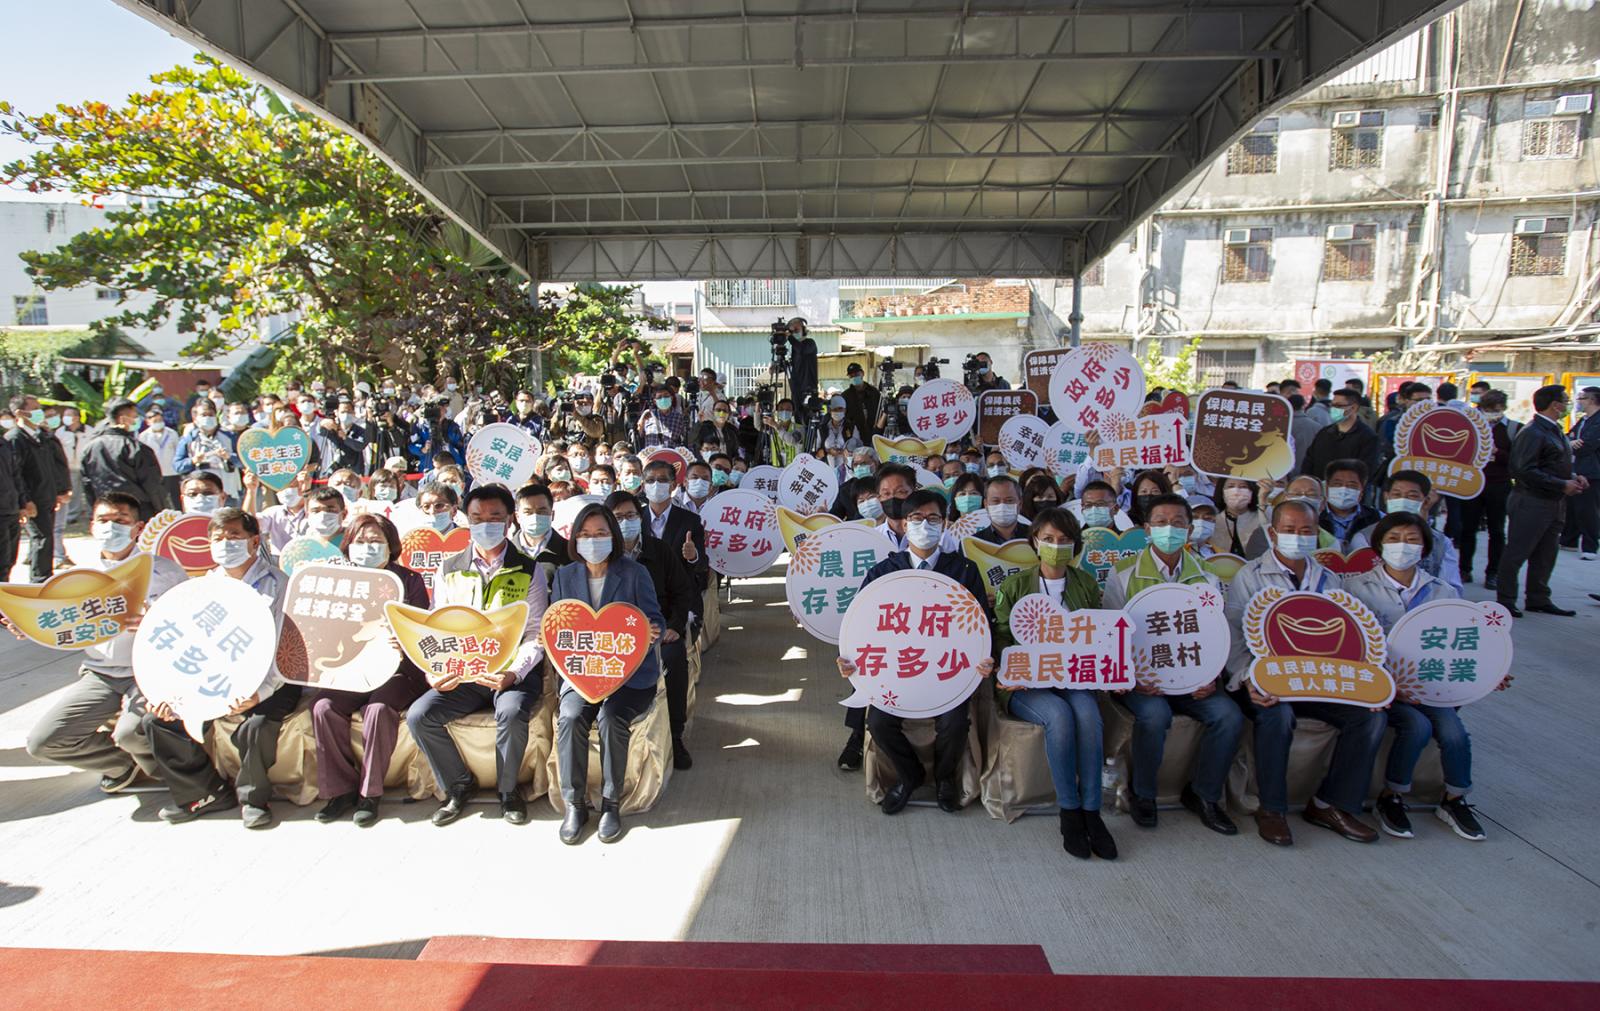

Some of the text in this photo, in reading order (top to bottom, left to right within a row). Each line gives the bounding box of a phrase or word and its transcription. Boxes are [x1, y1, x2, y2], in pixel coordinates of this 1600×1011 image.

[1064, 357, 1106, 403] 政府
[922, 391, 957, 410] 政府
[1077, 367, 1131, 429] 存多少
[1206, 397, 1265, 416] 保障農民
[916, 410, 968, 431] 存多少
[1118, 420, 1159, 441] 提升
[1203, 413, 1263, 432] 經濟安全
[1018, 425, 1044, 448] 幸福
[249, 444, 303, 461] 老年生活
[490, 437, 524, 463] 安居
[1011, 440, 1038, 461] 農村
[1058, 449, 1087, 465] 樂業
[1097, 444, 1185, 467] 農民福祉
[257, 461, 298, 476] 更安心
[481, 454, 514, 480] 樂業
[754, 478, 779, 492] 幸福
[789, 467, 815, 496] 幸福
[803, 478, 829, 506] 農村
[720, 506, 767, 531] 政府
[704, 528, 773, 557] 存多少
[817, 549, 877, 578] 農民
[38, 597, 126, 630] 老年生活
[877, 602, 952, 638] 政府
[1146, 608, 1200, 637] 幸福
[56, 619, 119, 646] 更安心
[192, 600, 254, 663] 農民
[557, 630, 635, 653] 農民退休
[1036, 614, 1097, 645] 提升
[1420, 626, 1480, 651] 安居
[147, 618, 232, 699] 存多少
[418, 635, 500, 660] 農民退休
[1151, 641, 1202, 670] 農村
[431, 656, 488, 677] 有儲金
[565, 655, 624, 676] 有儲金
[855, 644, 971, 682] 存多少
[1004, 651, 1129, 684] 農民福祉
[1265, 660, 1375, 683] 農民退休儲金
[1417, 658, 1477, 682] 樂業
[1288, 677, 1356, 694] 個人專戶
